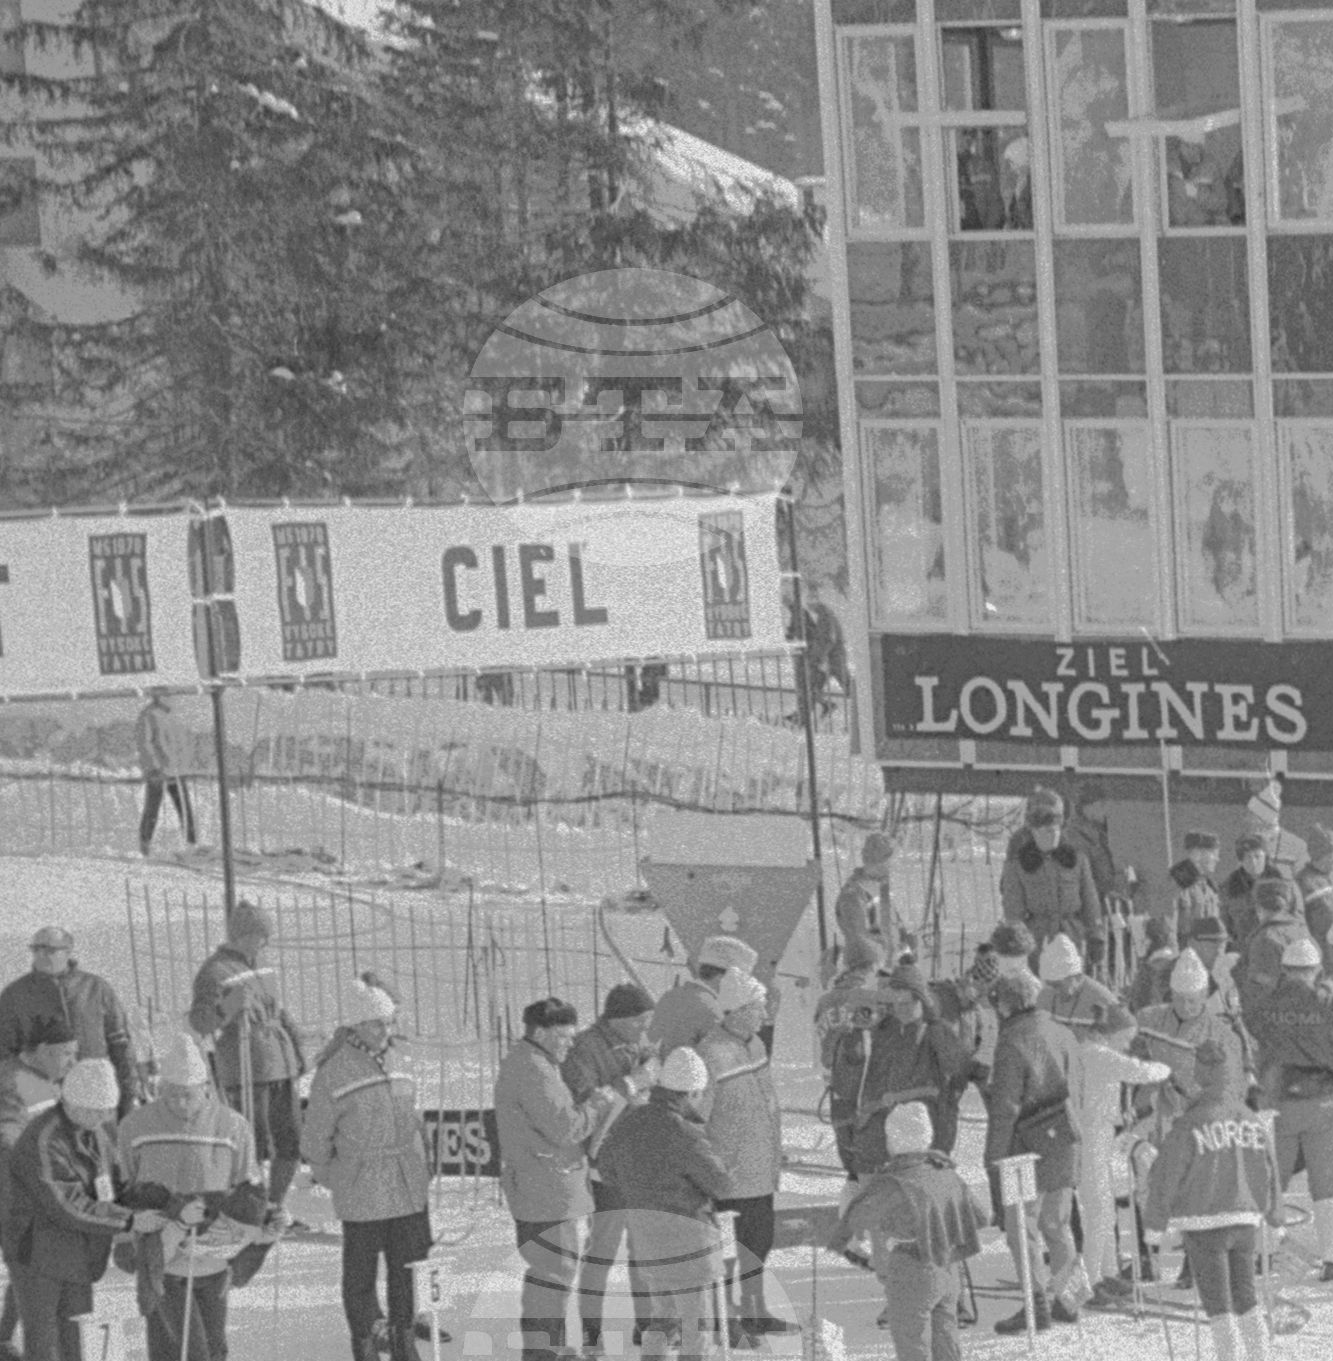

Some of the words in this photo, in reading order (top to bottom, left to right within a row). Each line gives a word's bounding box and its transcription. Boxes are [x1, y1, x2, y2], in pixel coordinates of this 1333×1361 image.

[441, 542, 608, 632] CIEL
[1056, 646, 1160, 678] ZIEL
[913, 675, 1309, 744] LONGINES
[1193, 1119, 1267, 1154] NORGE
